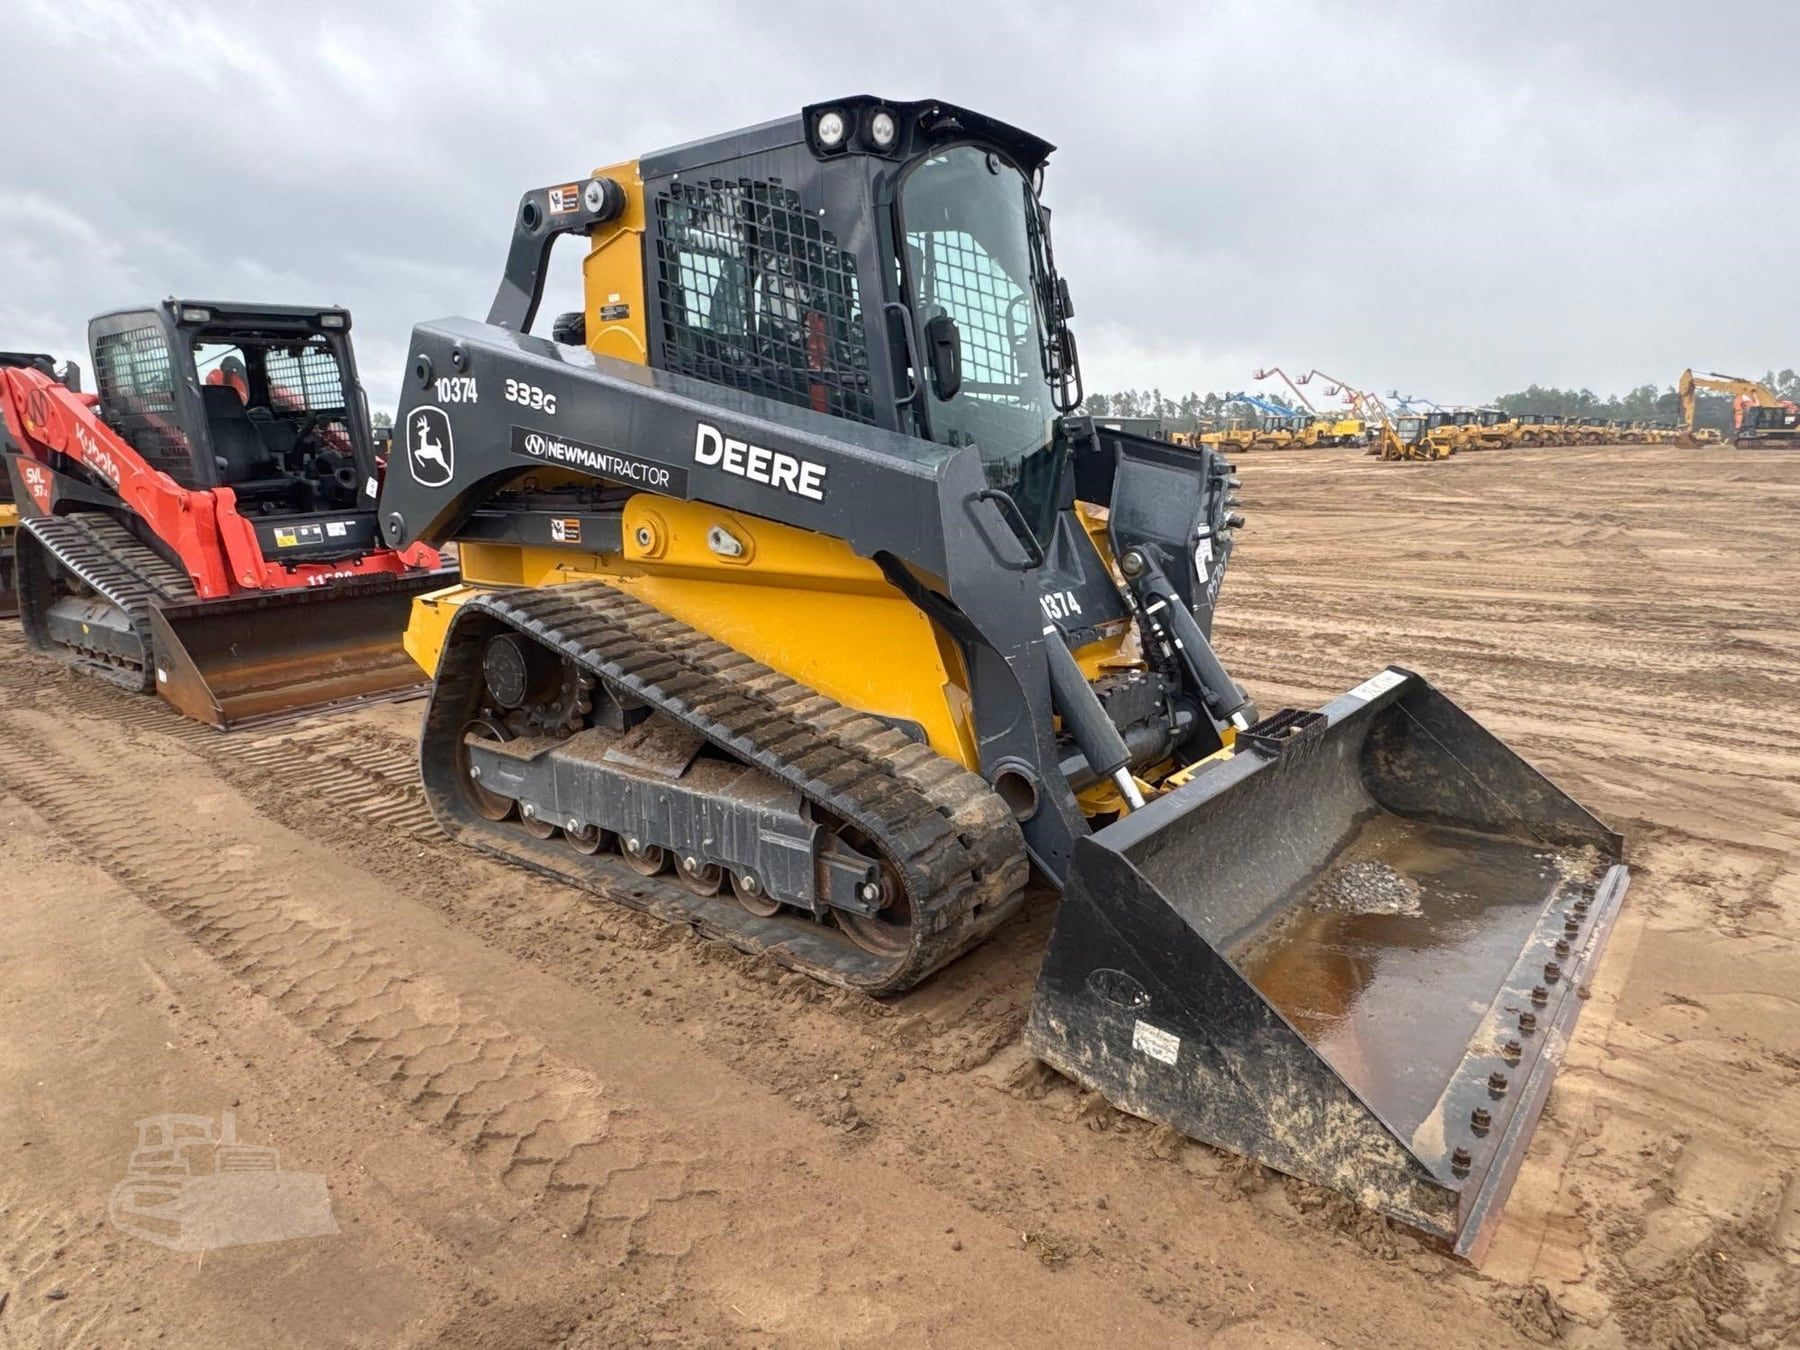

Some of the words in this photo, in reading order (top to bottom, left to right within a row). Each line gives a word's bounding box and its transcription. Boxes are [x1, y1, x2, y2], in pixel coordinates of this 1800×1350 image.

[434, 376, 478, 403] 10374
[505, 378, 556, 415] 333G
[75, 421, 120, 485] Kubota
[695, 423, 826, 501] DEERE
[26, 467, 45, 484] SVL
